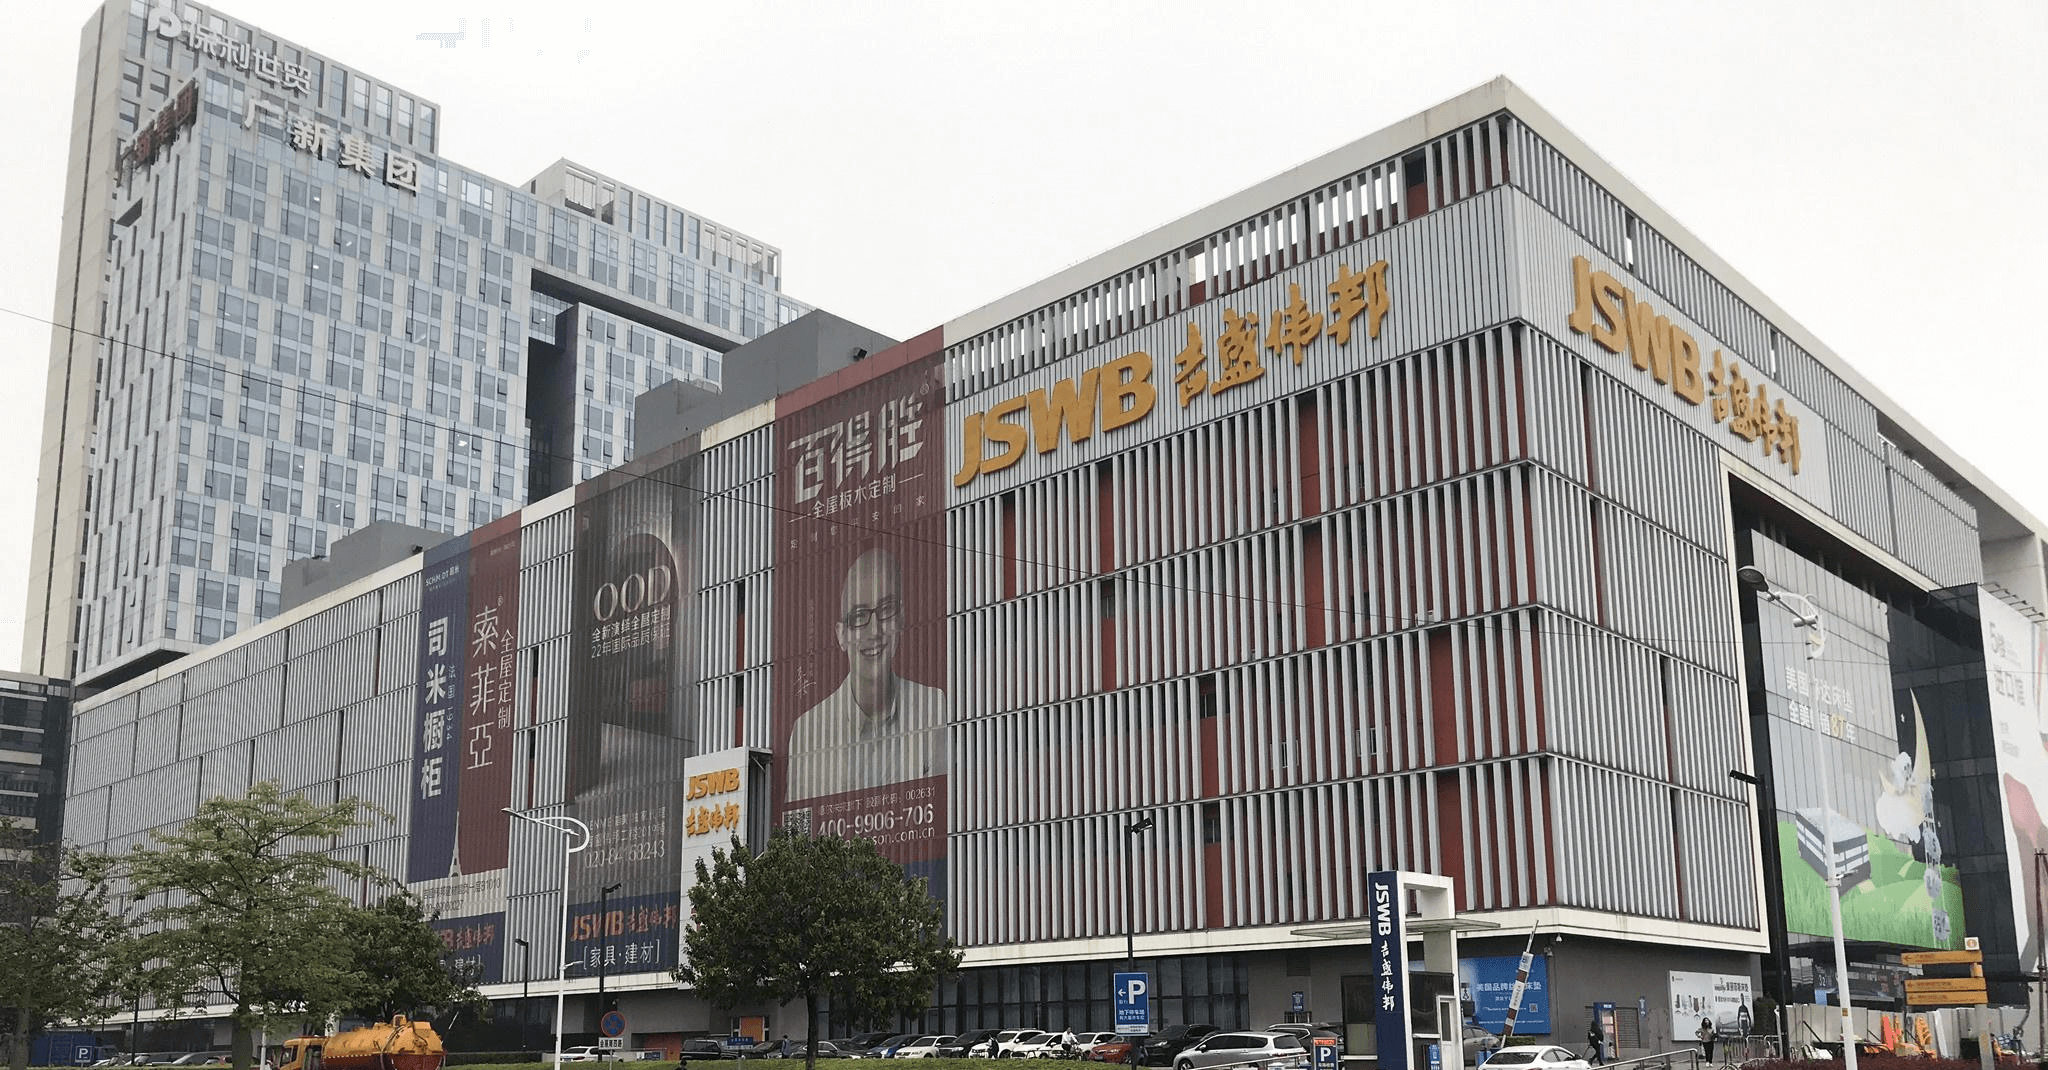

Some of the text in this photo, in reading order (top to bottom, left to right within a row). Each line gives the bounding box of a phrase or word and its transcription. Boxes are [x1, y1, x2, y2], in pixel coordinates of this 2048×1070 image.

[181, 22, 312, 95] 保利世贸
[244, 99, 423, 194] 广新集团
[954, 260, 1389, 488] JSWB 吉盛伟邦
[1568, 255, 1800, 476] JSWB 吉盛伟邦
[788, 392, 924, 505] 百得胜
[812, 474, 896, 519] 全屋板木定制
[421, 617, 448, 799] 司米橱柜
[497, 629, 514, 729] 全屋定制
[686, 772, 739, 801] JSWB
[686, 801, 739, 838] 吉盛伟邦
[818, 803, 935, 838] 400-9906-706
[1375, 882, 1395, 1011] JSWB 吉盛伟邦
[1128, 980, 1146, 1004] P
[79, 1047, 88, 1059] P
[1320, 1047, 1331, 1061] P
